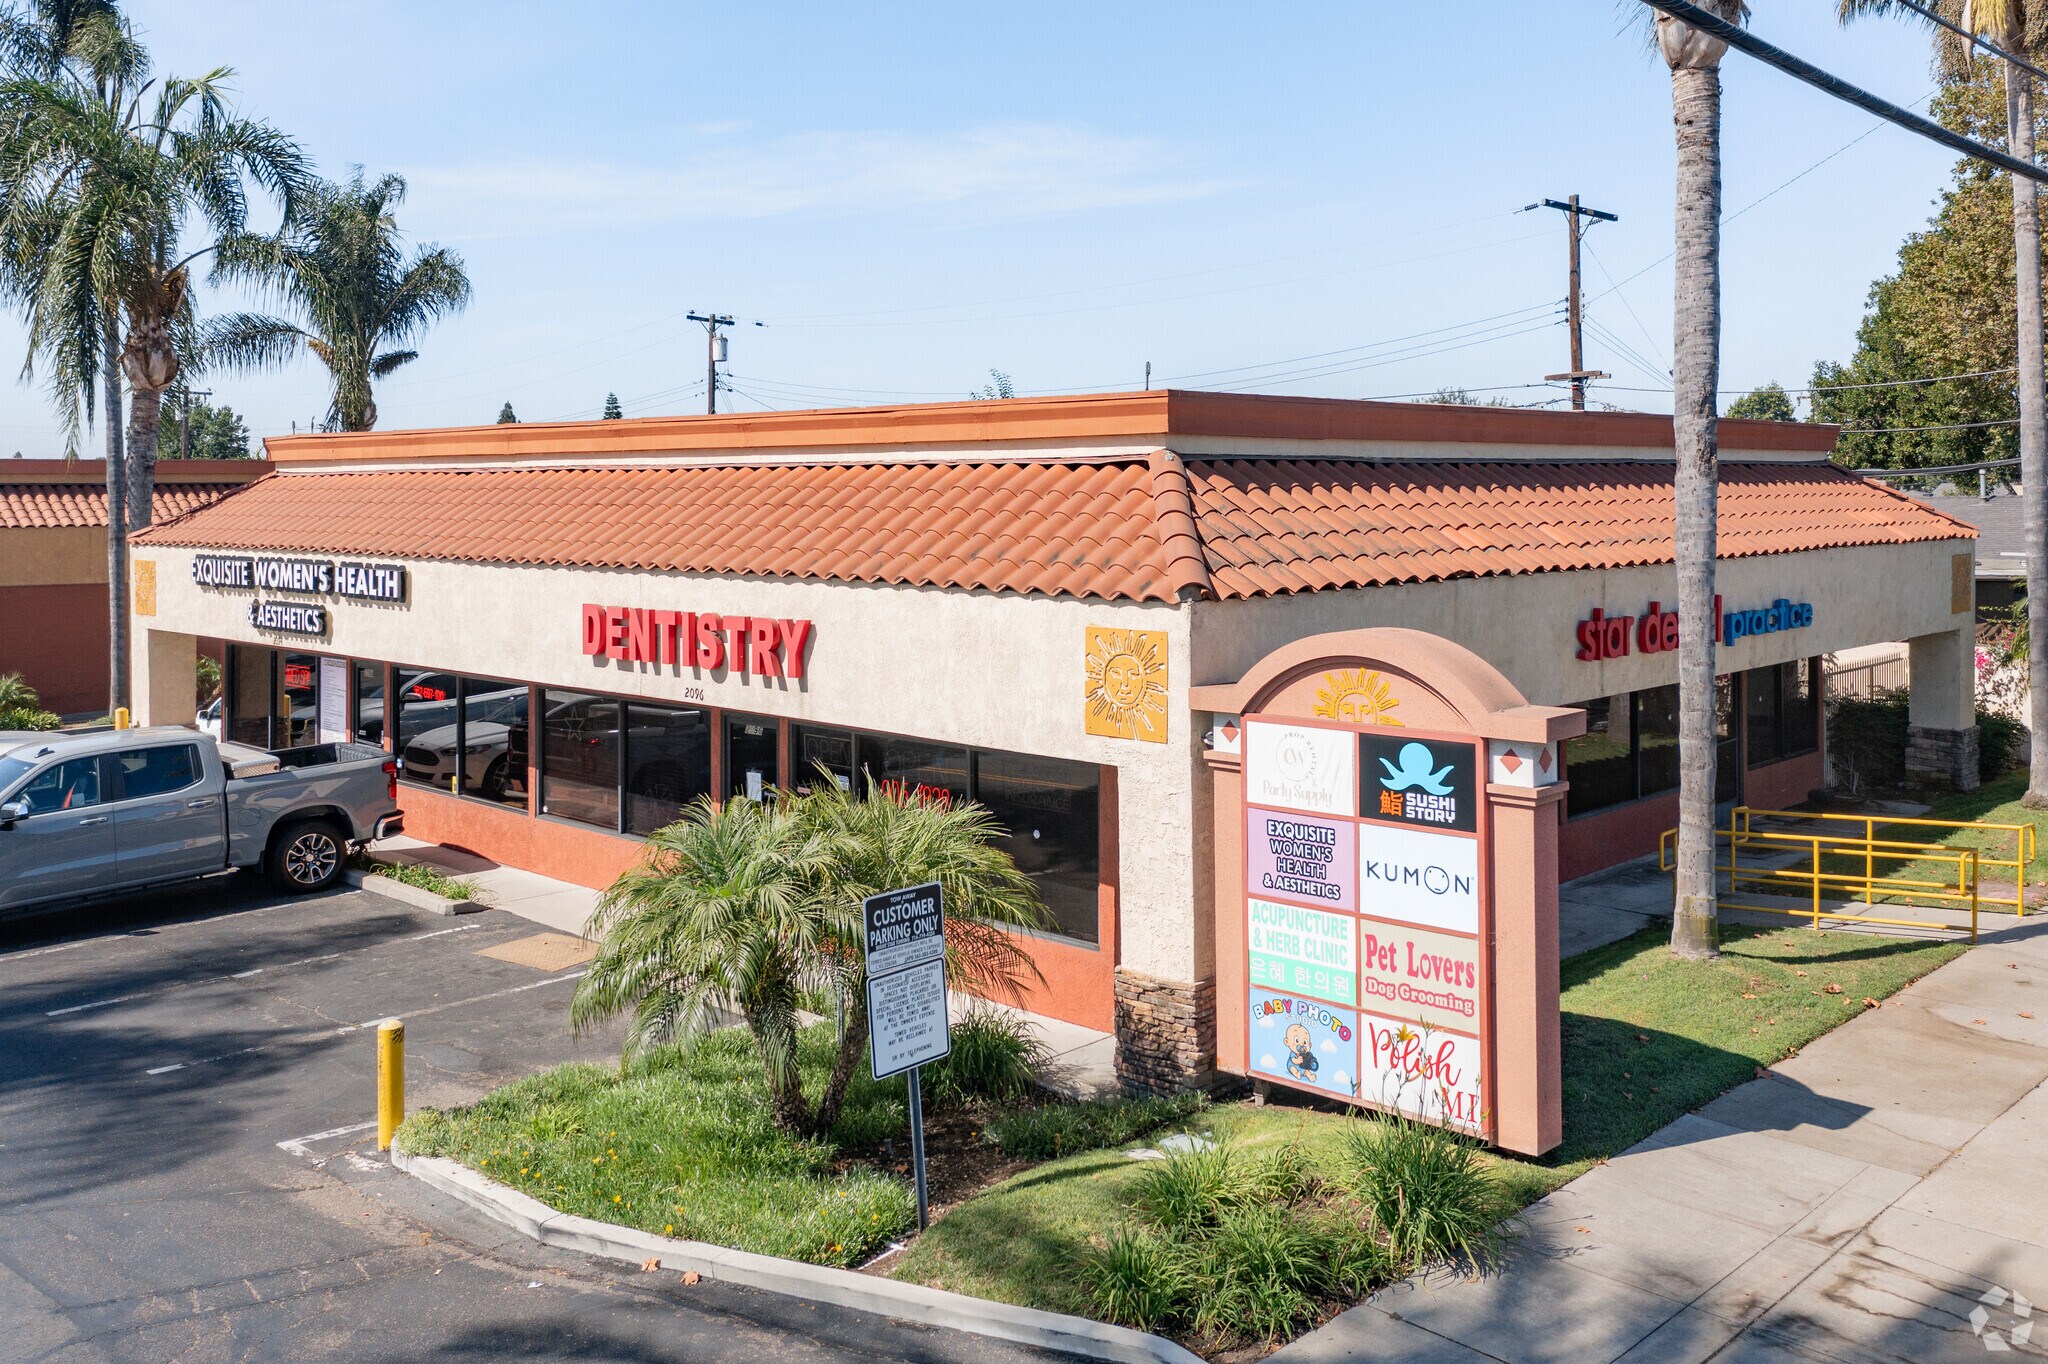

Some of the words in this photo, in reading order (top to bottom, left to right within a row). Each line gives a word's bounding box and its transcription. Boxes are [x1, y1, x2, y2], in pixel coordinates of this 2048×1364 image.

[192, 558, 250, 586] EXQUISITE
[253, 561, 332, 592] WOMEN'S
[334, 565, 402, 598] HEALTH
[247, 602, 256, 625] &
[257, 604, 324, 632] AESTHETICS
[1575, 608, 1633, 661] star
[1638, 594, 1722, 654] del
[1724, 598, 1813, 646] practice
[582, 603, 811, 678] DENTISTRY
[684, 687, 704, 701] 2096
[1263, 779, 1292, 803] Party
[1294, 783, 1332, 808] Supply
[1380, 790, 1403, 816] 鮨
[1406, 792, 1455, 811] SUSHI
[1406, 806, 1455, 823] STORY
[1267, 819, 1335, 845] EXQUISITE
[1269, 838, 1333, 862] WOMEN'S
[1276, 857, 1326, 879] HEALTH
[1366, 860, 1470, 894] KUMON
[902, 892, 916, 900] AWAY
[1263, 873, 1273, 888] &
[1275, 875, 1341, 900] AESTHETICS
[873, 897, 935, 926] CUSTOMER
[1252, 902, 1348, 940] ACUPUNCTURE
[870, 922, 911, 947] PARKING
[913, 915, 938, 934] ONLY
[870, 958, 882, 966] TOWED
[897, 950, 910, 958] VEHICLE
[926, 942, 941, 951] EXPENSE
[878, 945, 904, 956] UNAUTHORIZED
[904, 941, 920, 950] VEHICLES
[1253, 927, 1262, 948] &
[1266, 930, 1300, 955] HERB
[1304, 938, 1348, 966] CLINIC
[1365, 934, 1397, 973] Pet
[1406, 941, 1475, 989] Lovers
[873, 975, 902, 988] UNAUTHORIZED
[904, 969, 922, 980] VEHICLES
[924, 963, 938, 971] PARKED
[884, 989, 898, 998] SPACES
[910, 978, 931, 990] DISPLAYING
[886, 980, 909, 991] DESIGNATED
[911, 972, 933, 983] ACCESSIBLE
[1251, 957, 1284, 983] 은혜
[1295, 966, 1350, 998] 한의원
[876, 1005, 891, 1014] SPECIAL
[894, 999, 909, 1008] LICENSE
[911, 993, 925, 1002] PLATES
[927, 988, 940, 997] ISSUED
[879, 993, 908, 1006] DISTINGUISHING
[910, 986, 930, 997] PLACARDS
[886, 1007, 904, 1017] PERSONS
[917, 995, 941, 1007] DISABILITIES
[1366, 976, 1396, 1000] Dog
[1398, 983, 1474, 1017] Grooming
[901, 1016, 917, 1025] OWNER'S
[919, 1009, 936, 1019] EXPENSE
[907, 1008, 919, 1017] TOWED
[1253, 999, 1292, 1019] BABY
[1297, 1001, 1351, 1041] PHOTO
[1285, 1013, 1318, 1028] STUDIO
[894, 1029, 906, 1037] TOWED
[909, 1022, 926, 1032] VEHICLES
[906, 1028, 926, 1040] RECLAIMED
[907, 1042, 932, 1056] TELEPHONING
[1369, 1022, 1461, 1086] Polish
